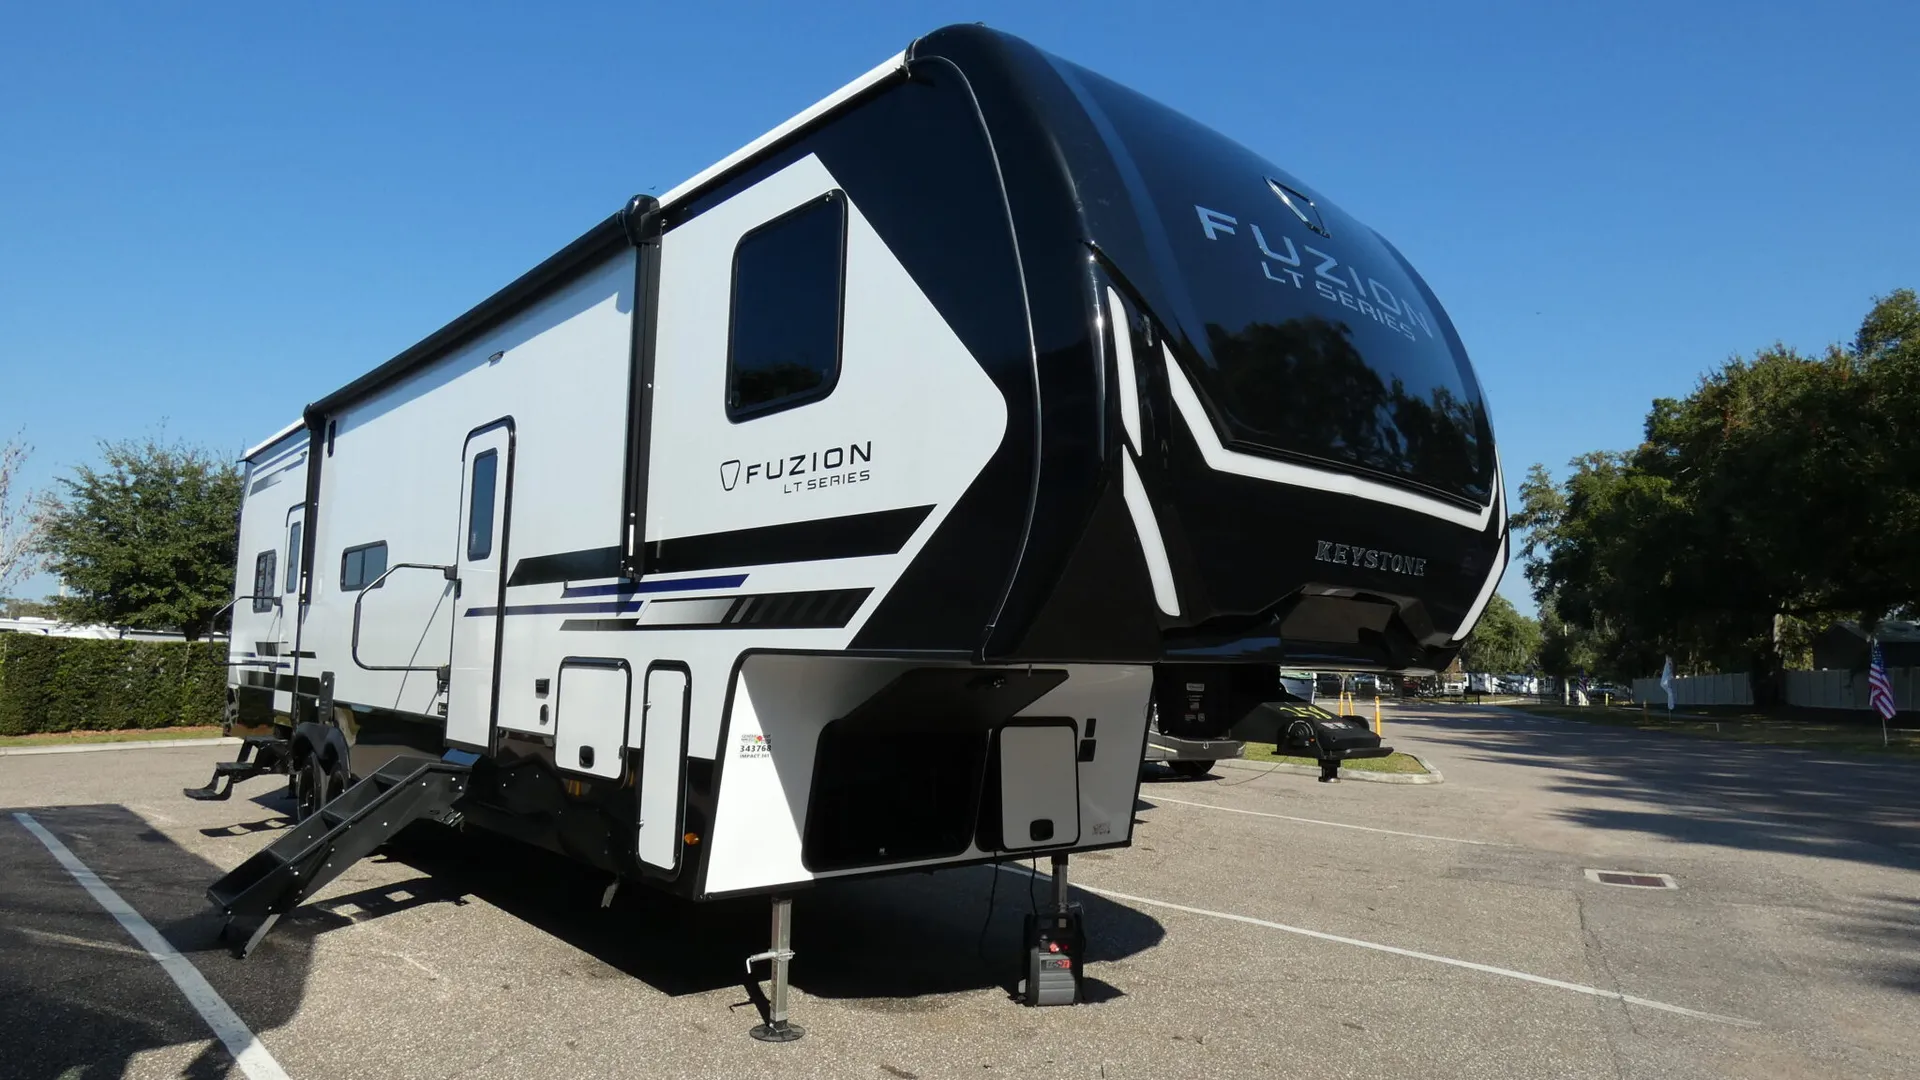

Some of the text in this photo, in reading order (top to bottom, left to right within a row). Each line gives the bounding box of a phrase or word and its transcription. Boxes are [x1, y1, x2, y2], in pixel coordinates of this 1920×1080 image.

[1194, 204, 1433, 338] FUZION
[1261, 261, 1416, 342] LT SERIES
[746, 441, 872, 484] FUZION
[784, 470, 870, 494] LT SERIES
[1315, 540, 1427, 576] KEYSTONE
